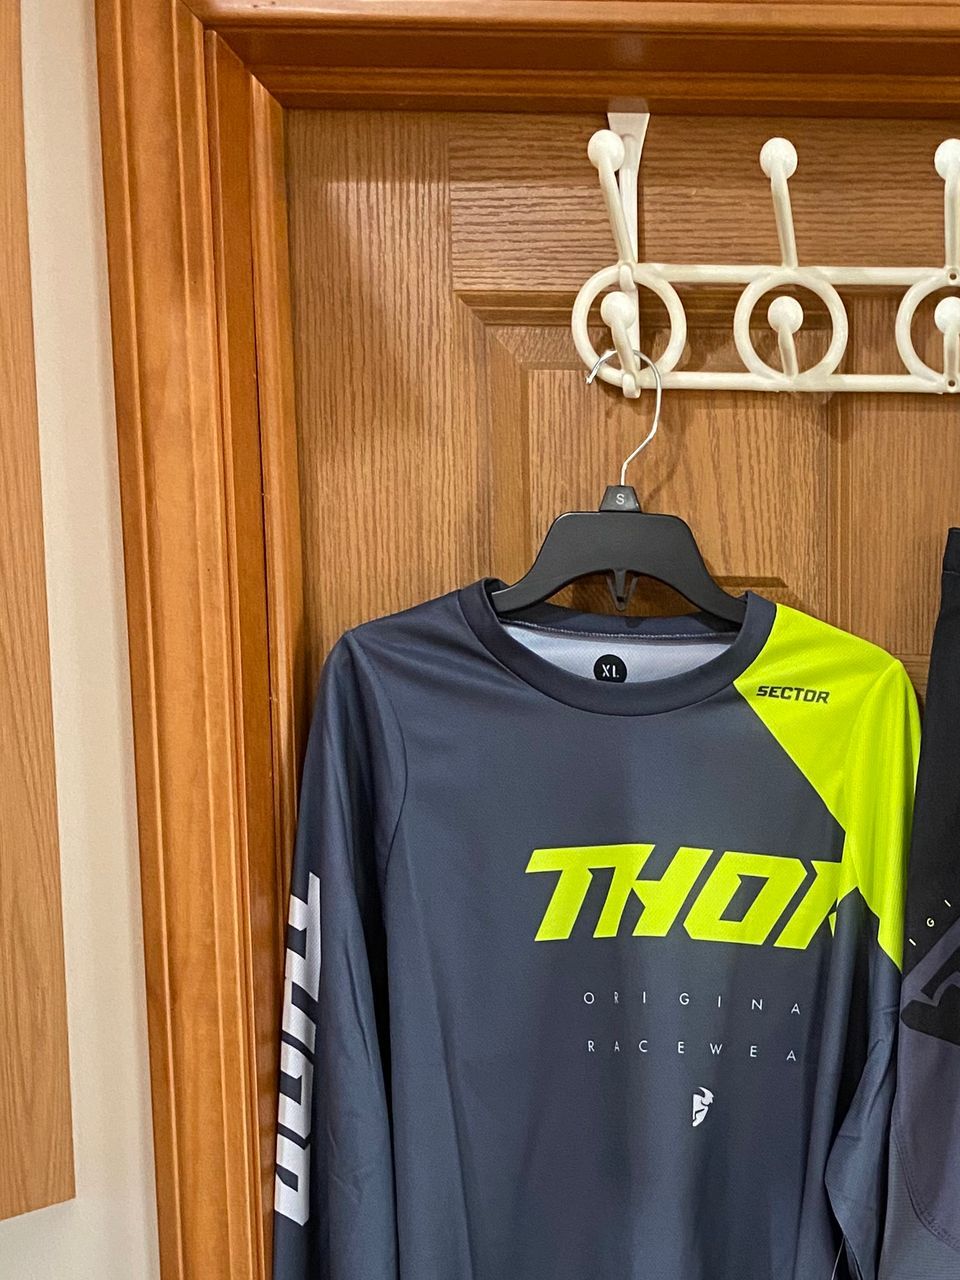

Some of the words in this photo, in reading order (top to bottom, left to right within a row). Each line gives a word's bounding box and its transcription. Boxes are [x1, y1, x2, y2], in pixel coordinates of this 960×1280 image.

[615, 493, 625, 506] S
[601, 664, 620, 678] XL
[756, 685, 830, 704] SECTOR
[583, 990, 801, 1015] ORIGINA
[588, 1039, 797, 1062] RACEWEA
